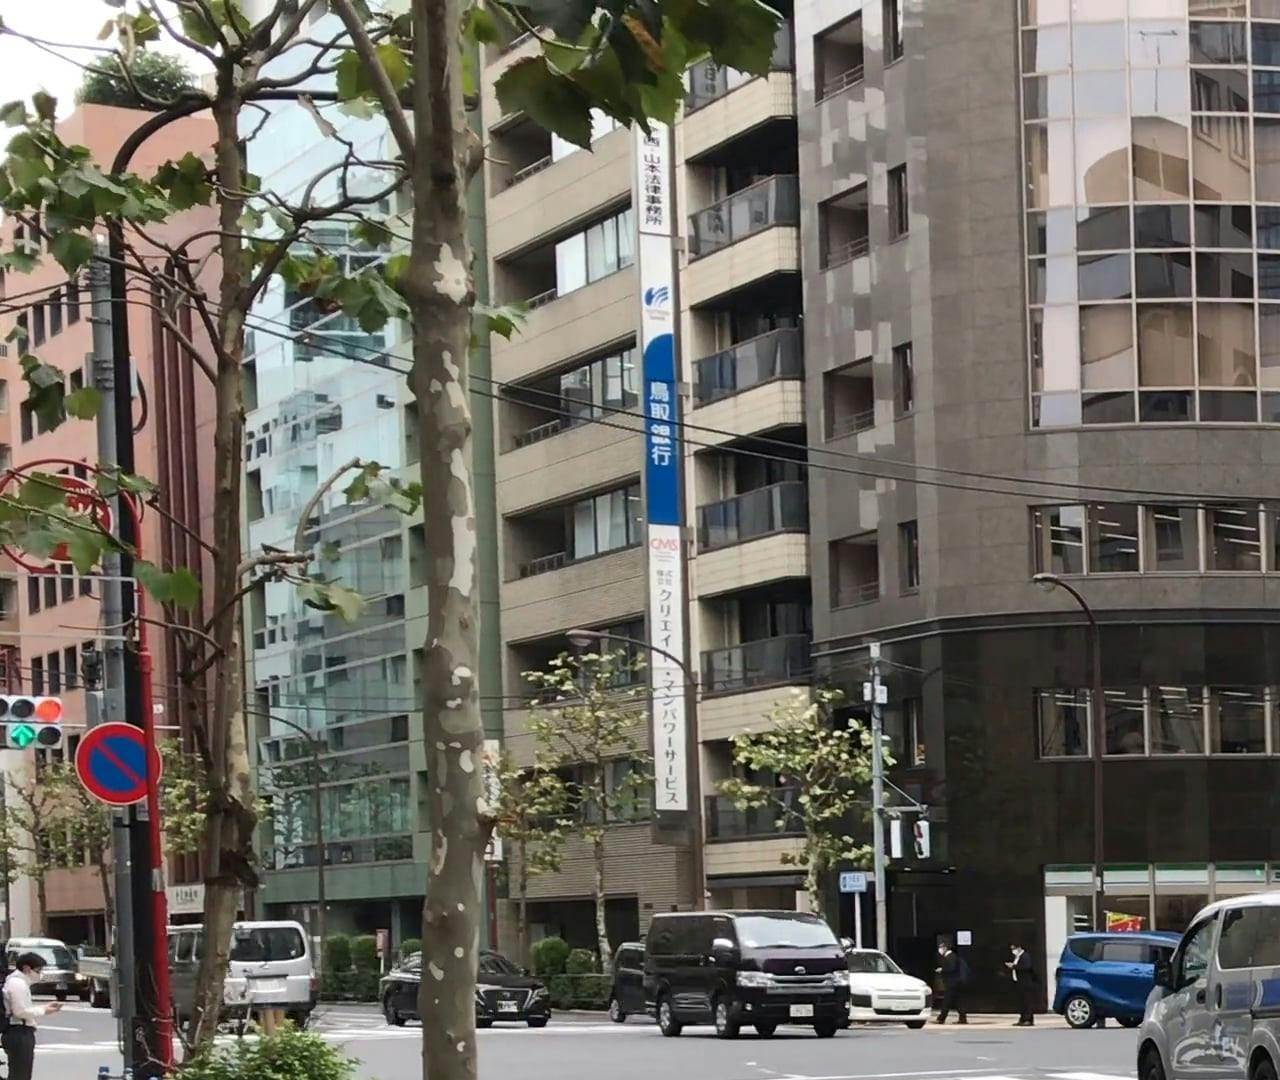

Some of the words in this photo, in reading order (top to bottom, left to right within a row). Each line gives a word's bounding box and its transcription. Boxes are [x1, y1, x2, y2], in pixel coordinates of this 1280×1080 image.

[650, 381, 672, 466] 鳥取銀行
[651, 538, 679, 551] CMS
